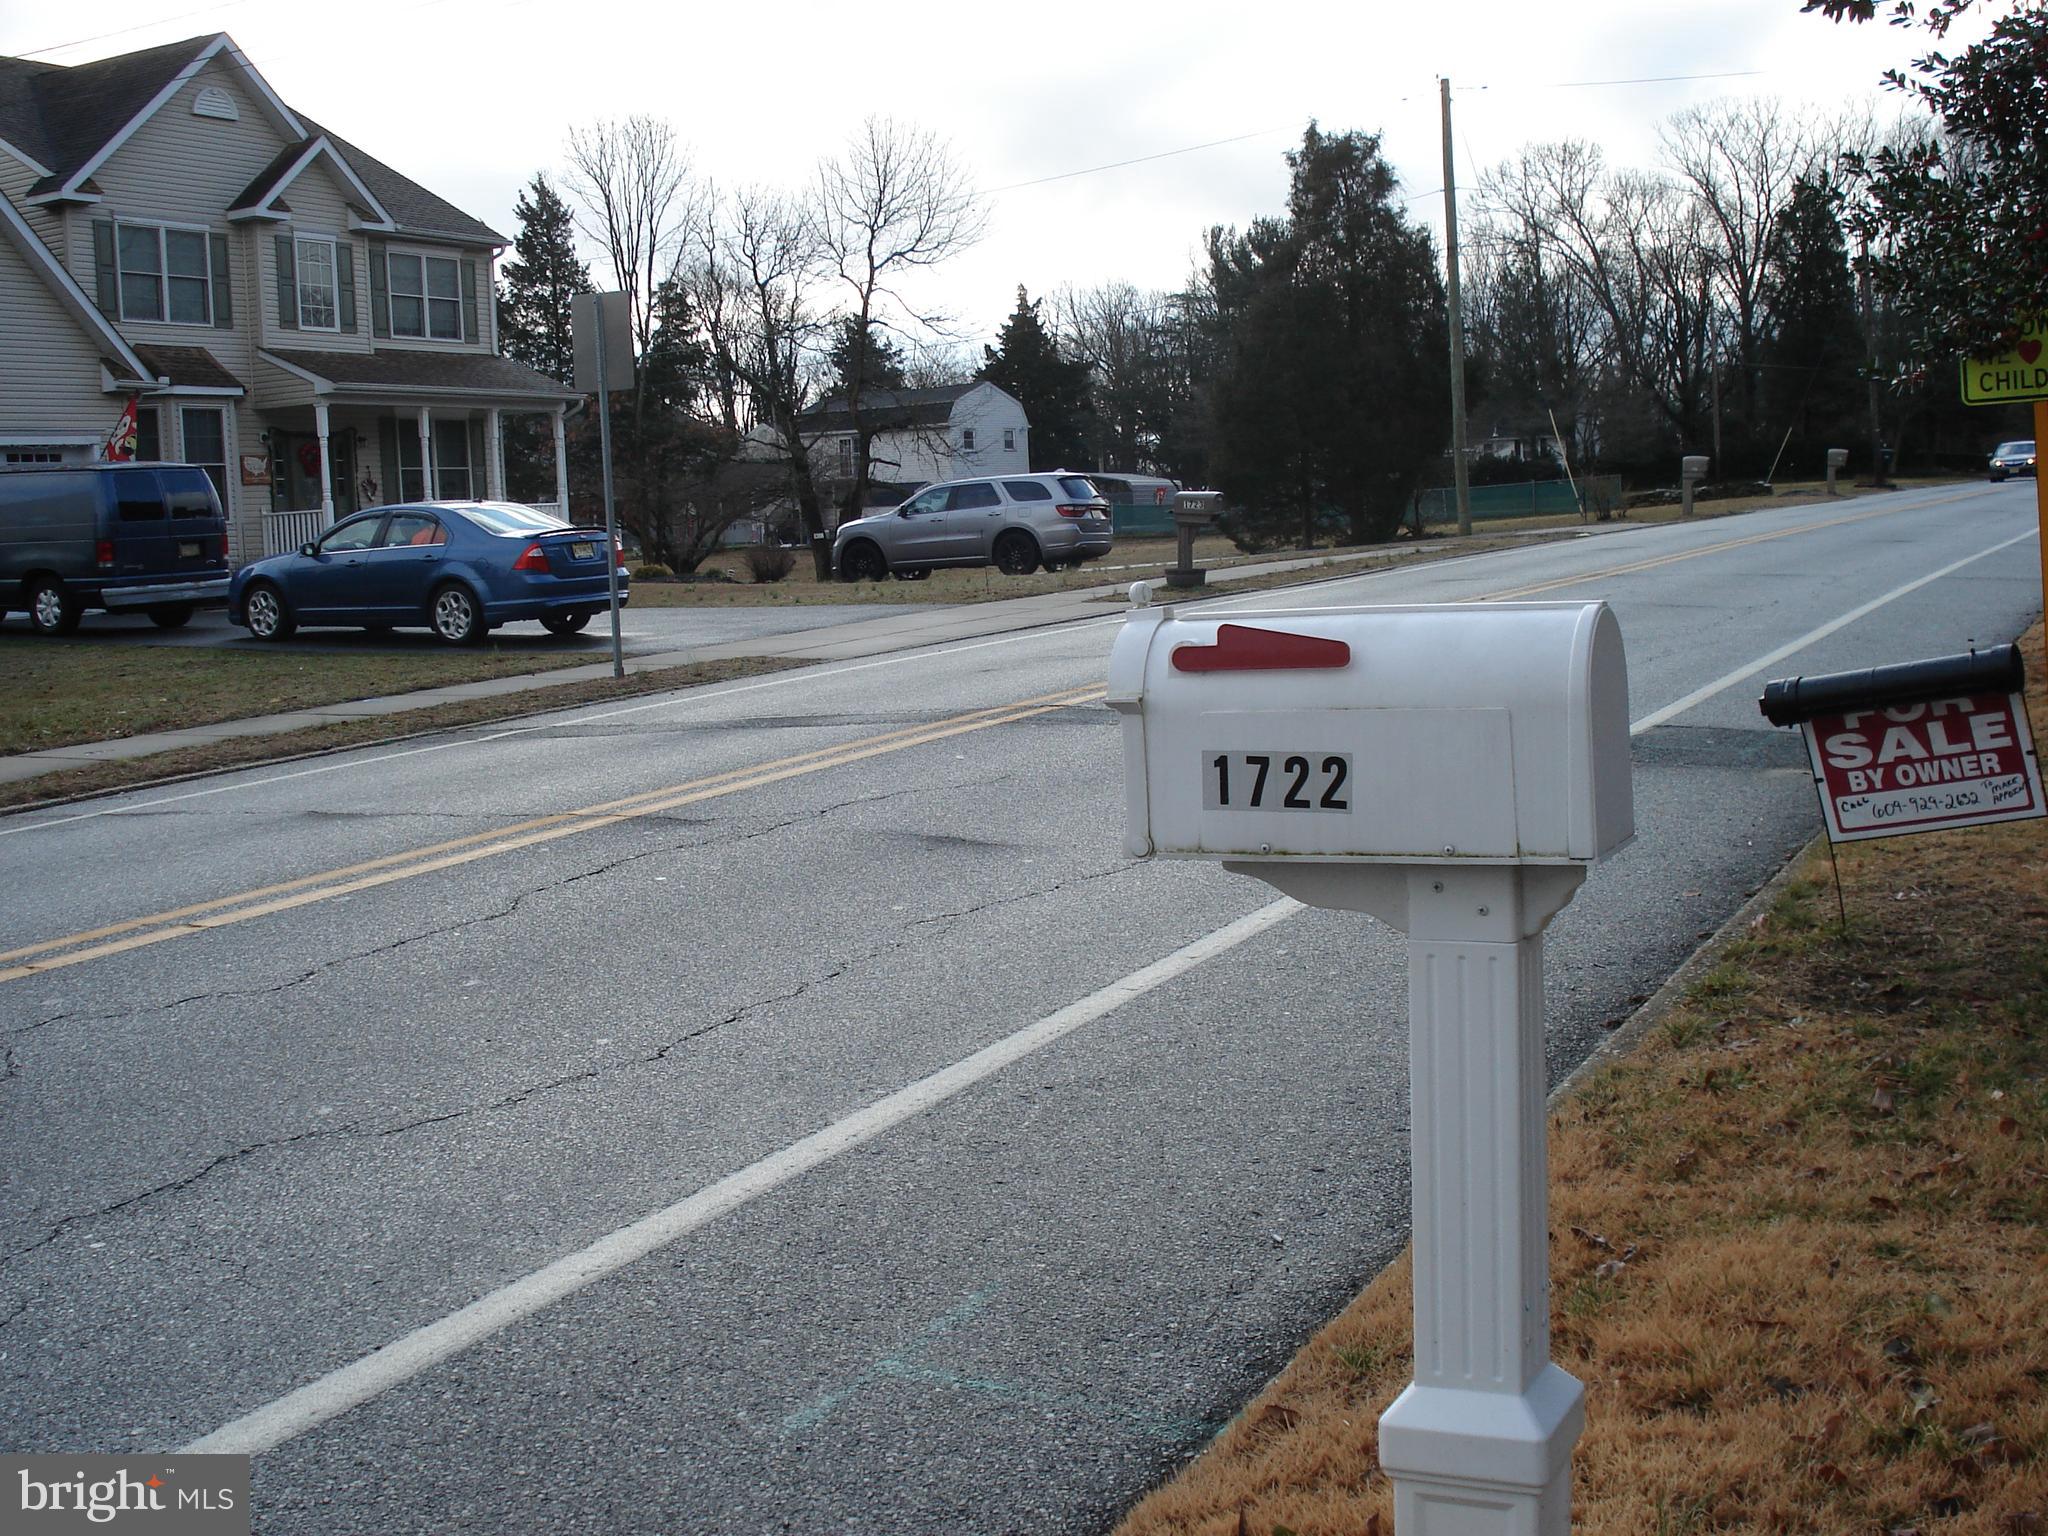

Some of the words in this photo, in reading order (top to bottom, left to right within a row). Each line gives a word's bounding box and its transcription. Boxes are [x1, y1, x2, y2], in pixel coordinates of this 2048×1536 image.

[1825, 711, 2013, 769] SALE
[1214, 755, 1348, 809] 1722
[1847, 767, 1887, 793] BY
[1895, 753, 2001, 786] OWNER
